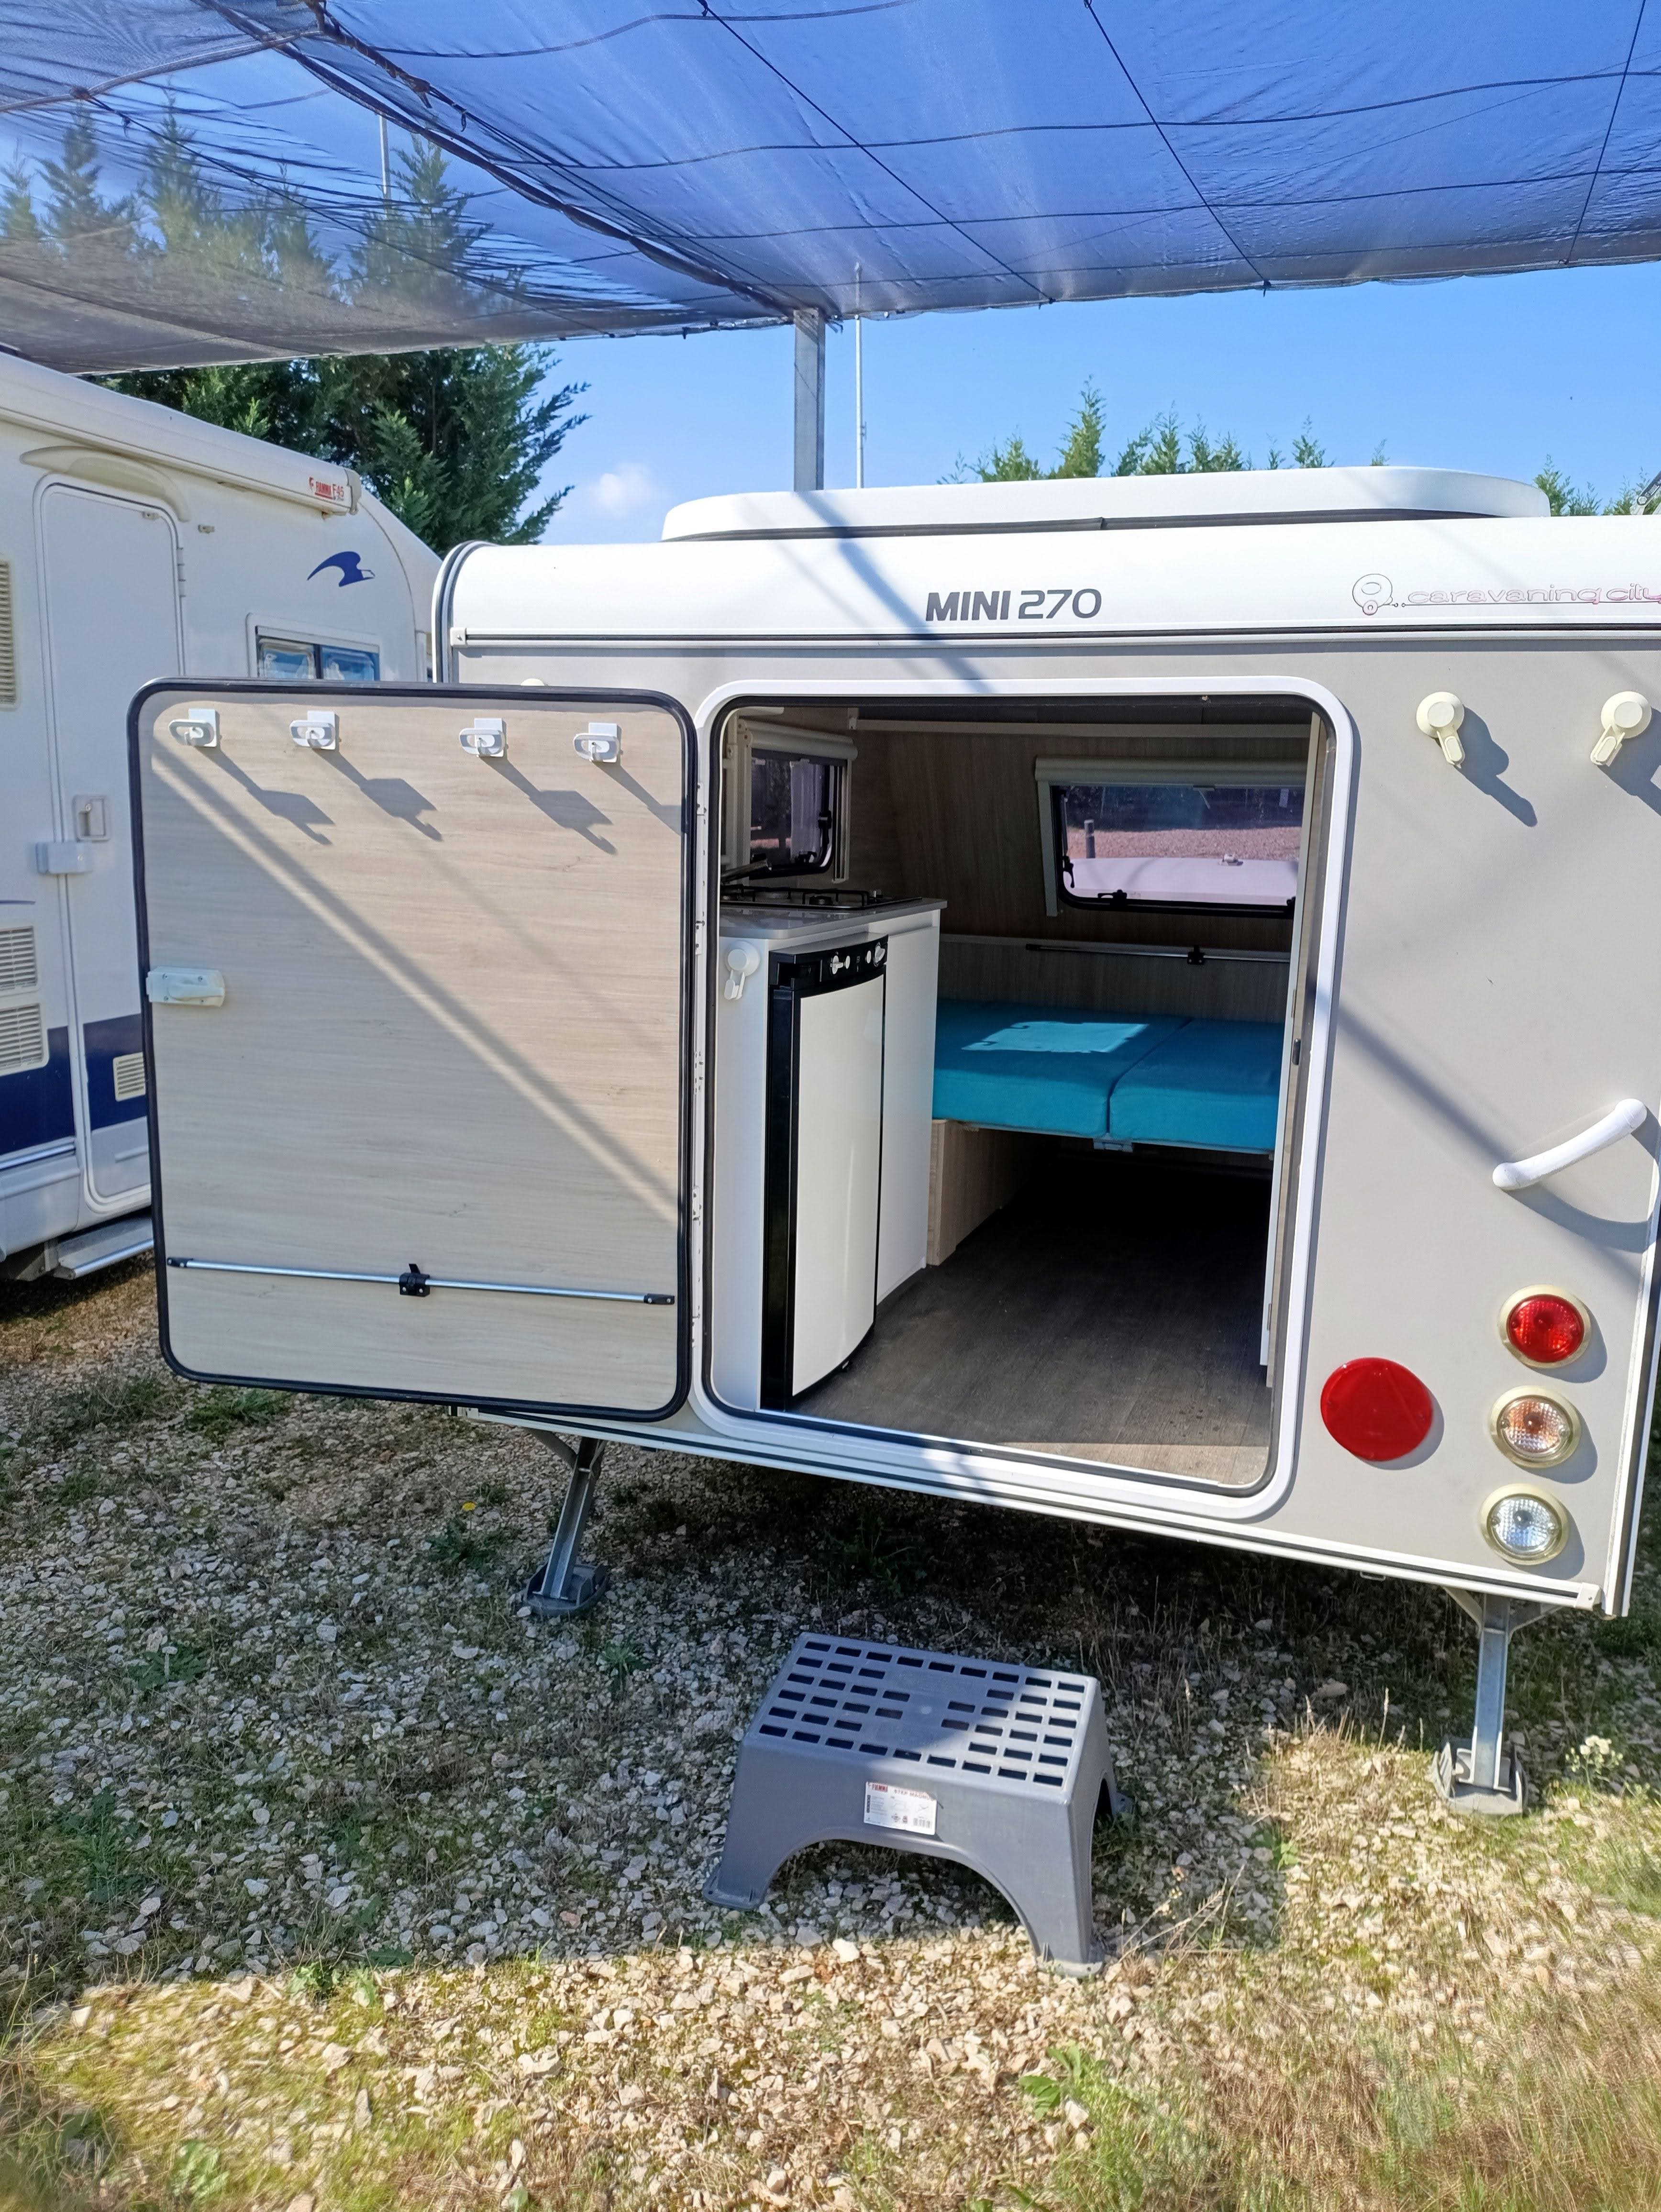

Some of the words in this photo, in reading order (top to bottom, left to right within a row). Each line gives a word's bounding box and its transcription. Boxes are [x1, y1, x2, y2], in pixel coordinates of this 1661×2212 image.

[332, 484, 344, 498] F45
[1408, 584, 1602, 604] caravaning
[926, 590, 1011, 621] MINI
[1018, 588, 1101, 619] 270
